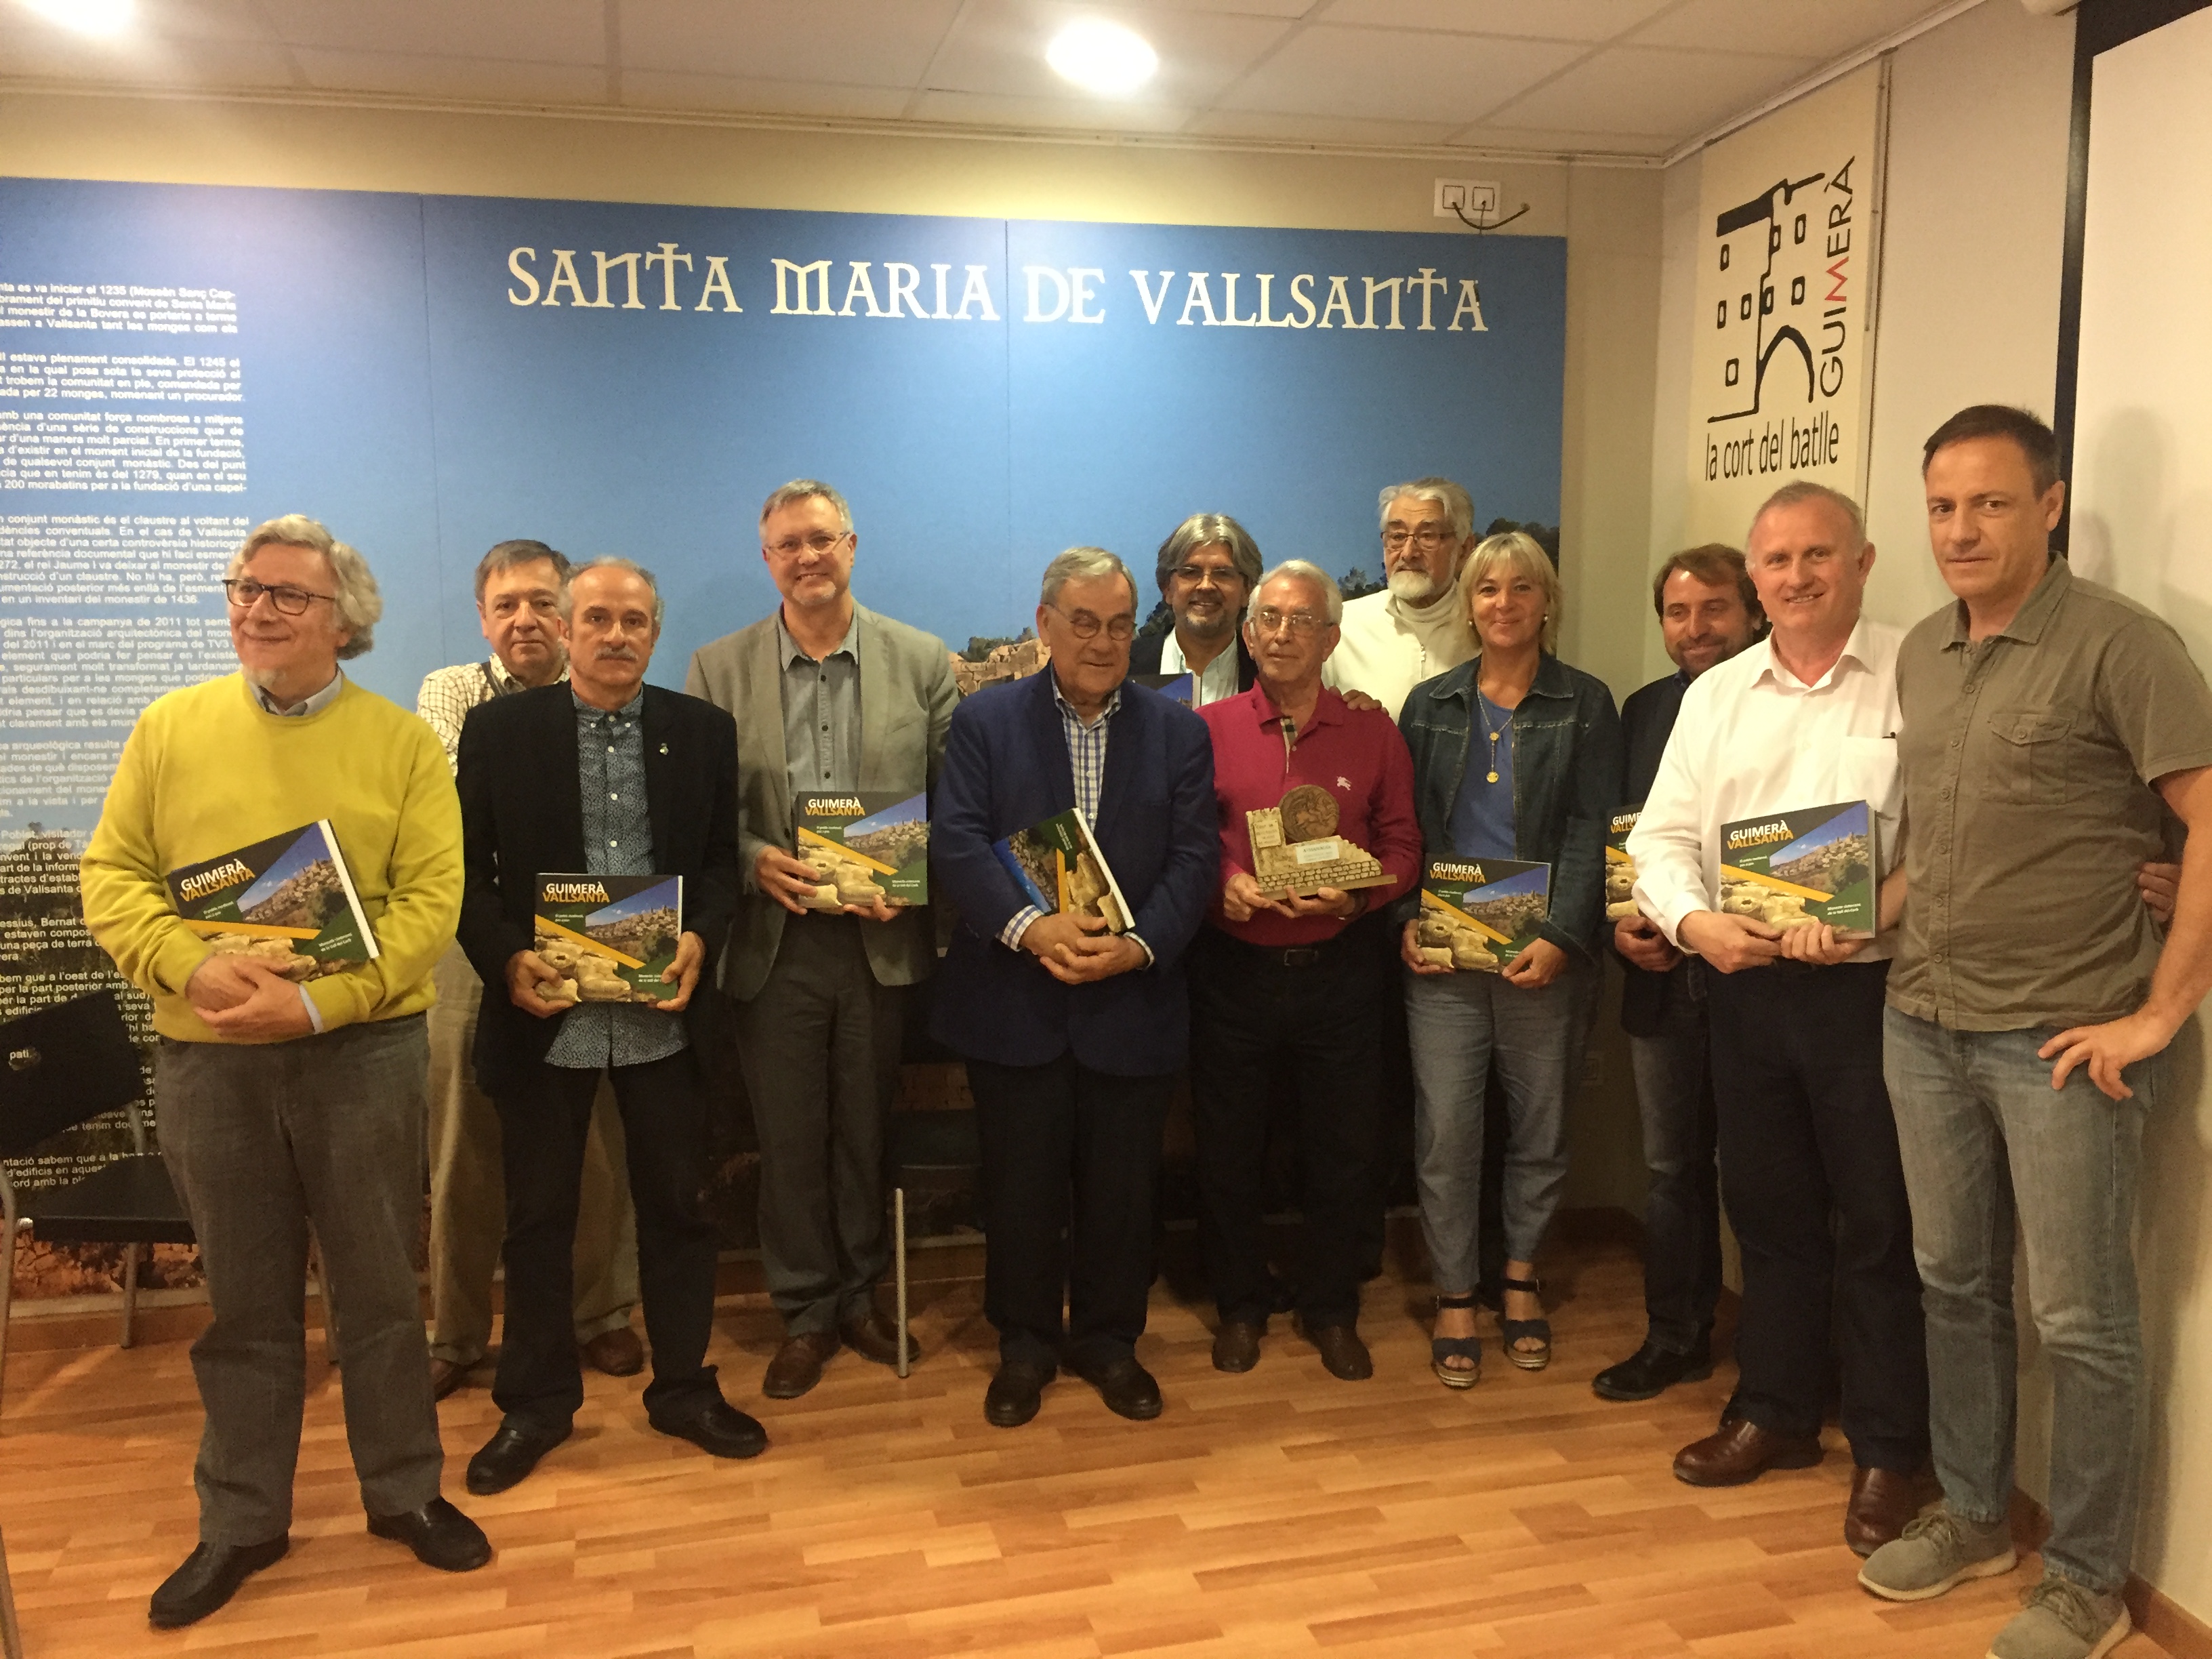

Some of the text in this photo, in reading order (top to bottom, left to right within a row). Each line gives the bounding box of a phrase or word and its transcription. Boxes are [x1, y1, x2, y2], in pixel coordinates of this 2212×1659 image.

[1820, 155, 1856, 398] GUIMERÀ
[507, 242, 1489, 332] SANTA MARIA DE VALLSANTA
[1705, 410, 1840, 482] la cort del batlle
[808, 796, 861, 808] GUIMERÀ
[805, 806, 865, 816] VALLSANTA
[1730, 819, 1788, 840] GUIMERÀ
[1727, 829, 1794, 851] VALLSANTA
[180, 858, 246, 891] GUIMERÀ
[1433, 862, 1482, 875] GUIMERÀ
[1429, 869, 1486, 883] VALLSANTA
[24, 884, 73, 894] Vallsanta
[180, 867, 255, 902] VALLSANTA
[546, 881, 605, 894] GUIMERÀ
[543, 893, 610, 903] VALLSANTA
[41, 917, 76, 926] Bernat
[4, 929, 46, 939] estaven
[23, 942, 48, 951] peça
[52, 939, 64, 948] de
[68, 938, 92, 947] terra
[26, 975, 45, 983] que
[91, 970, 104, 979] de
[19, 984, 28, 993] la
[31, 983, 53, 994] part
[56, 981, 102, 994] posterior
[16, 994, 67, 1005] la part de
[38, 1154, 73, 1164] sabem
[77, 1155, 96, 1164] que
[34, 1176, 68, 1186] amb la
